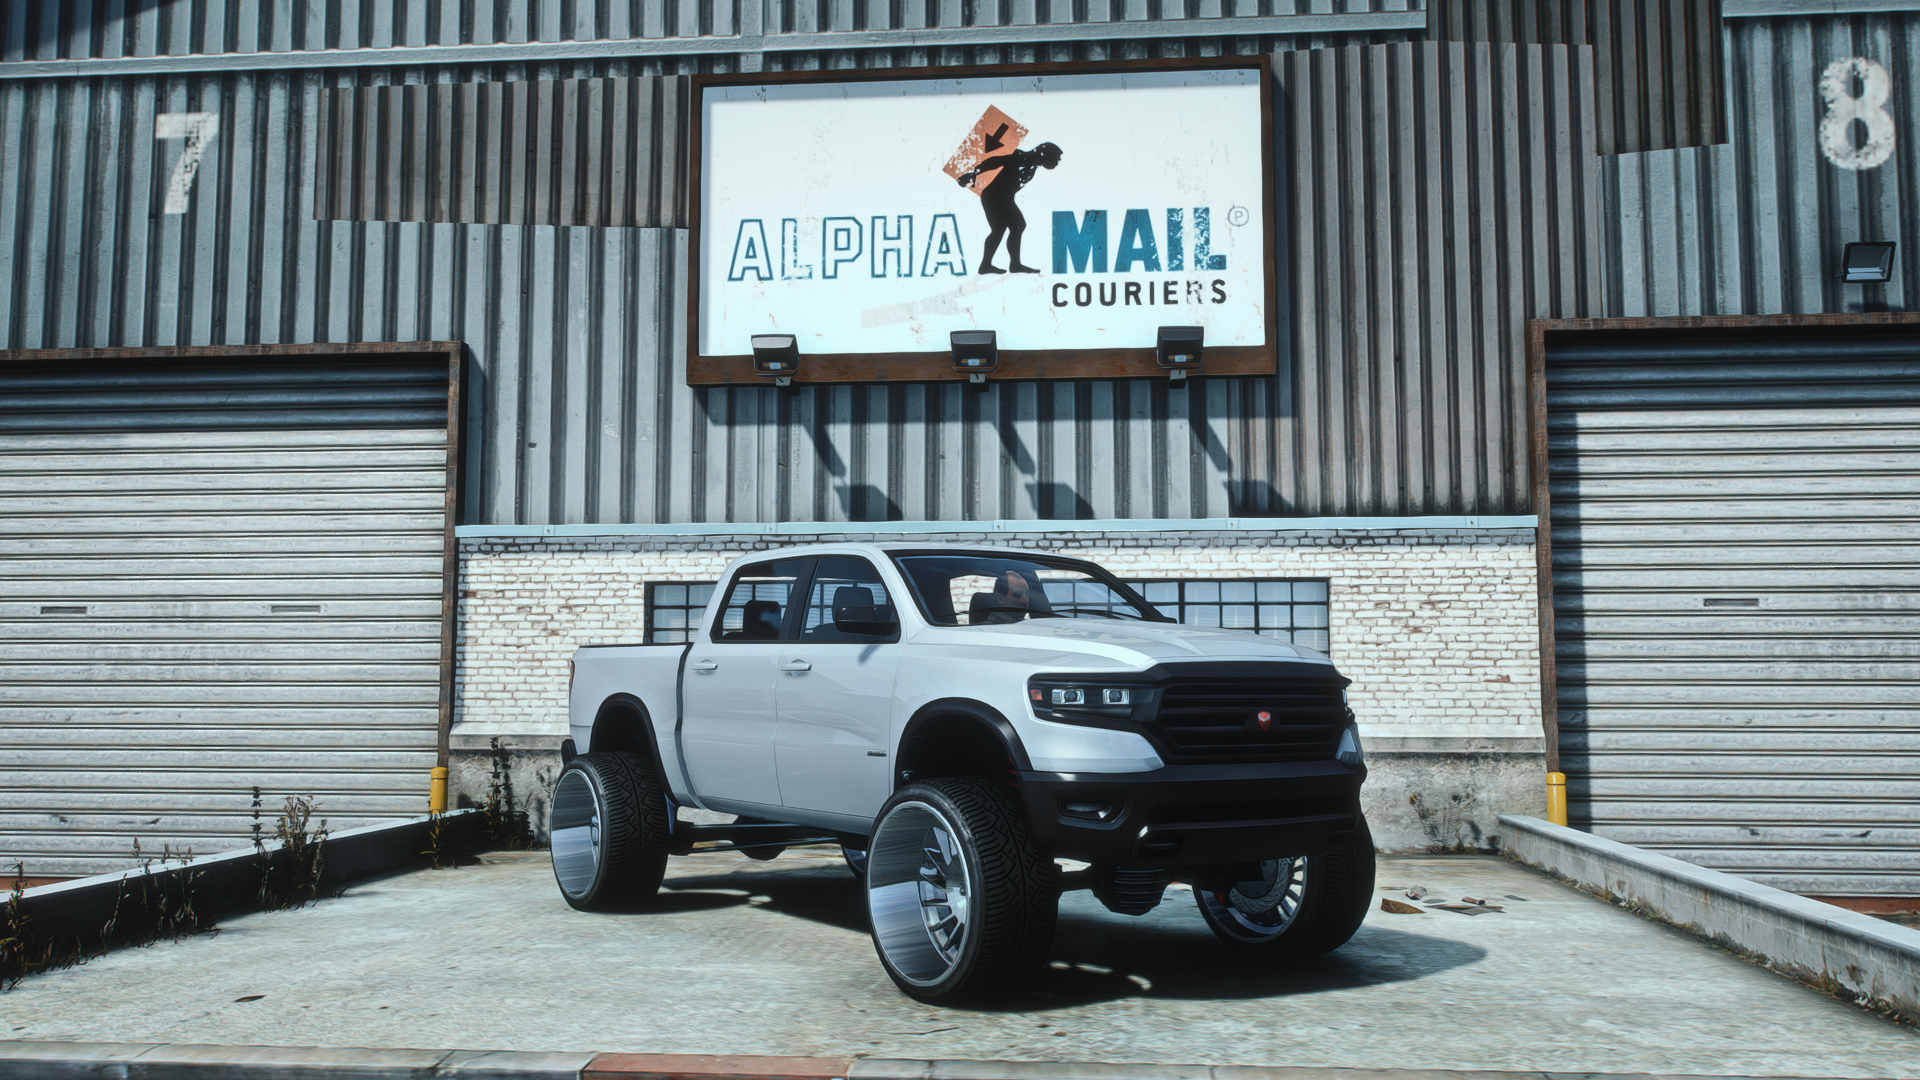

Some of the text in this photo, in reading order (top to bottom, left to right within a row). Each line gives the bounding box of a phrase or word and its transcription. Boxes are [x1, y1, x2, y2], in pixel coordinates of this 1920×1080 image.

[1819, 57, 1895, 170] 8
[155, 112, 219, 215] 7
[727, 213, 968, 282] ALPHA
[1051, 207, 1228, 275] MAIL
[1052, 278, 1227, 308] COURIERS
